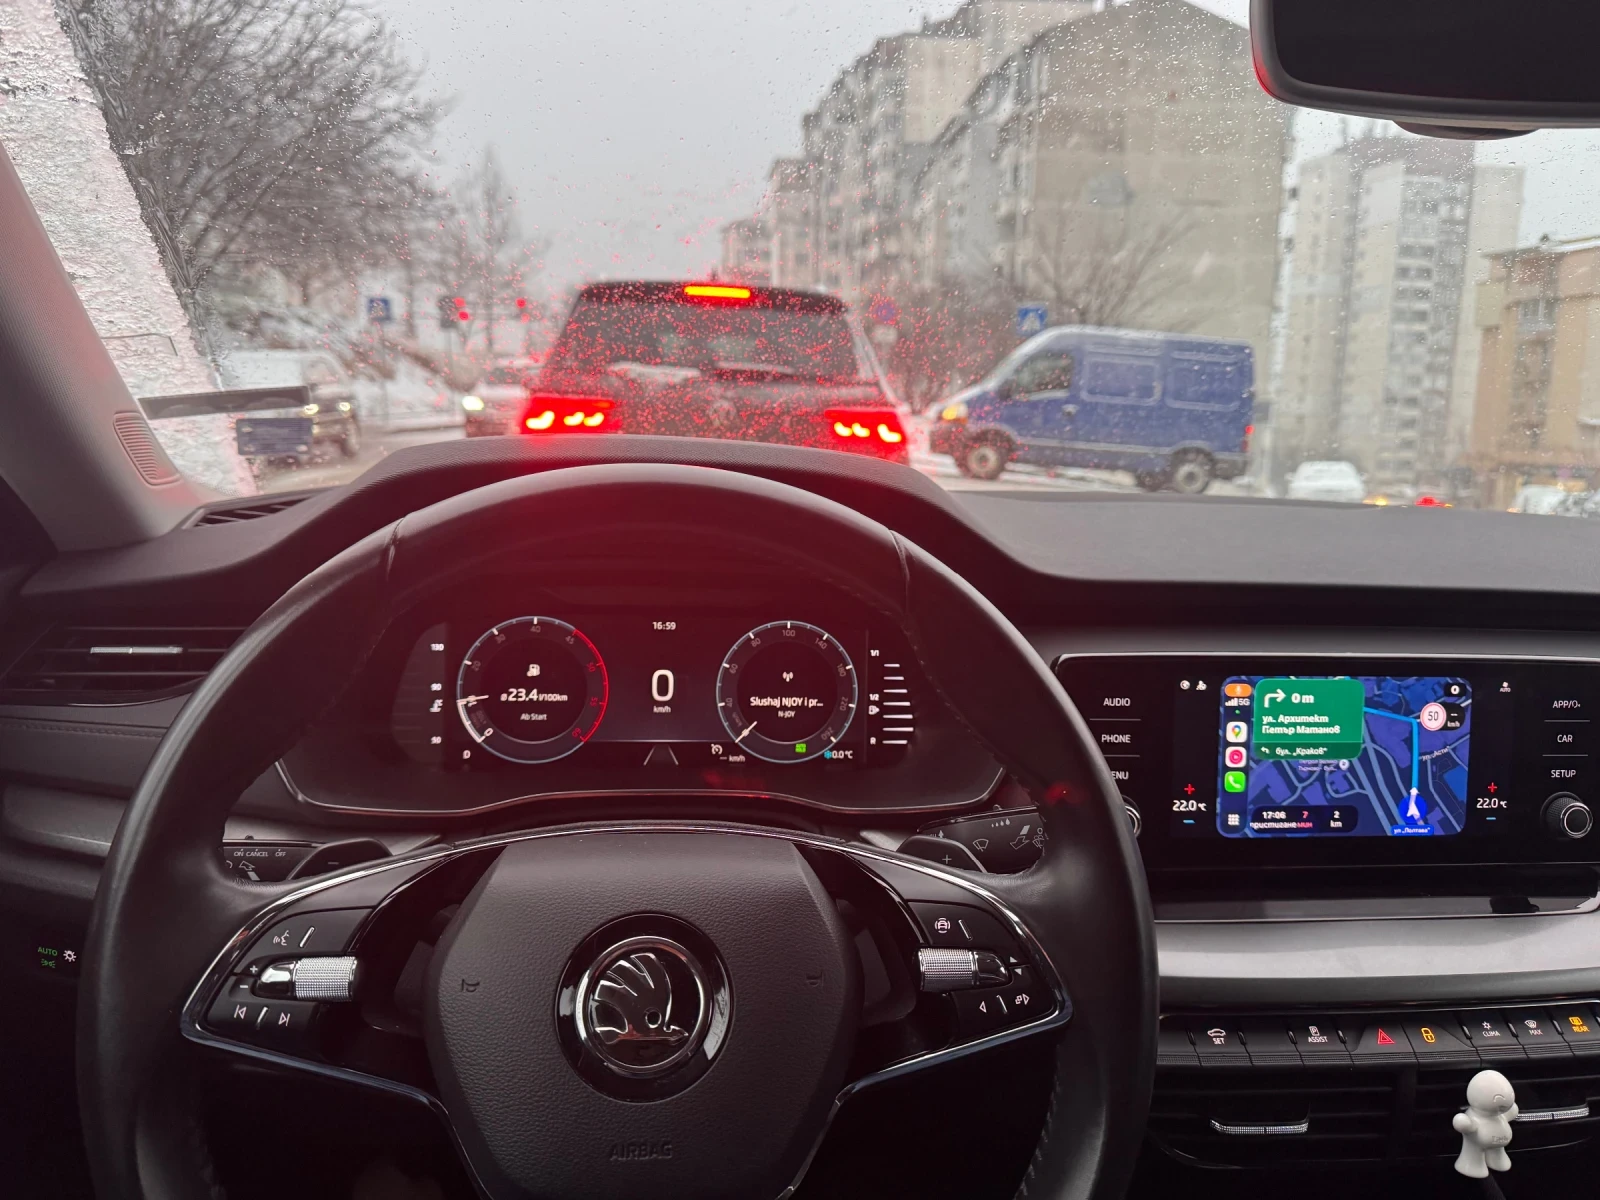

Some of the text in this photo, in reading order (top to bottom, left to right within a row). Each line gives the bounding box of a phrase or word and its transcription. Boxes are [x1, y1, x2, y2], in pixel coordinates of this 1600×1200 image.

[652, 621, 676, 630] 16:59
[751, 638, 761, 647] 80
[815, 638, 827, 649] 140
[730, 663, 738, 674] 60
[837, 664, 846, 677] 180
[430, 683, 442, 691] 90
[652, 669, 674, 701] 0
[750, 696, 780, 708] Slushaj
[782, 697, 803, 707] NJOY
[1103, 698, 1131, 707] AUDIO
[1291, 693, 1314, 703] 0 m
[778, 710, 795, 718] N-JOY
[1428, 711, 1439, 721] 50
[1101, 734, 1131, 743] PHONE
[1557, 734, 1573, 743] CAR
[1111, 771, 1129, 780] ENU
[1551, 769, 1576, 778] SETUP
[1172, 800, 1197, 811] 22.0
[1476, 798, 1498, 809] 22.0
[1262, 811, 1286, 819] 17:06
[1302, 811, 1309, 819] 7
[1333, 811, 1340, 819] 2
[1330, 820, 1342, 828] km
[38, 946, 58, 957] AUTO
[609, 1141, 673, 1160] AIRBAG
